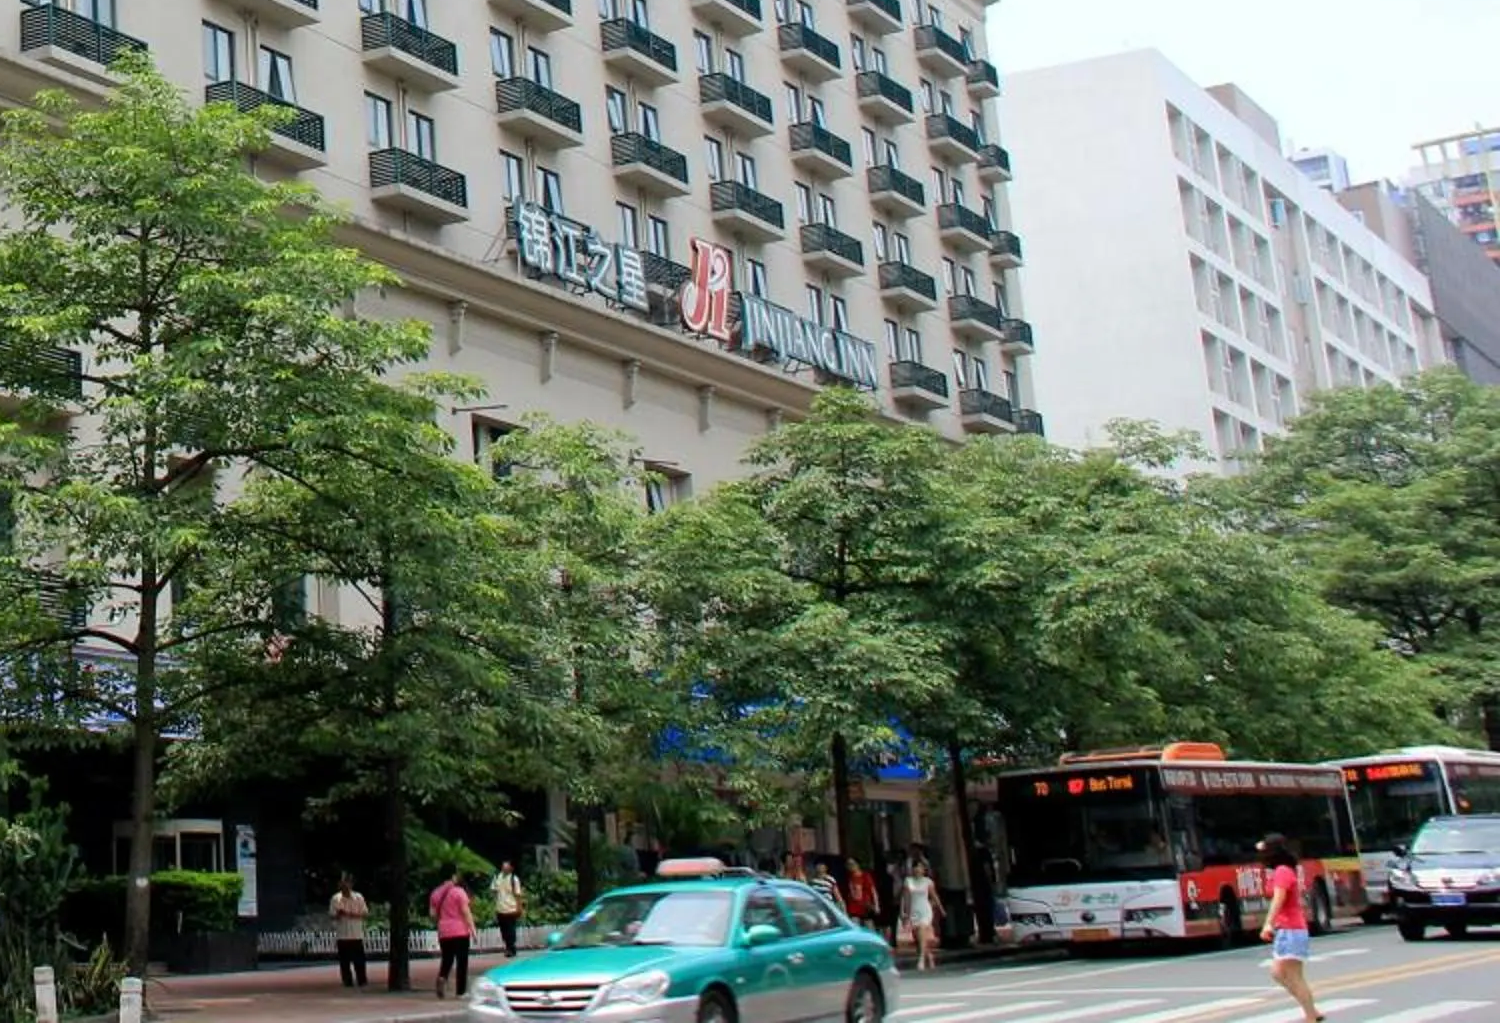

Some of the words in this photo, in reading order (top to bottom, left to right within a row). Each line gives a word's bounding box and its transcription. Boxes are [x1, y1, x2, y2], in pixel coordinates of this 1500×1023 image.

[515, 196, 650, 316] 锦江之星
[741, 293, 837, 373] JINJIANG
[834, 330, 878, 388] INN
